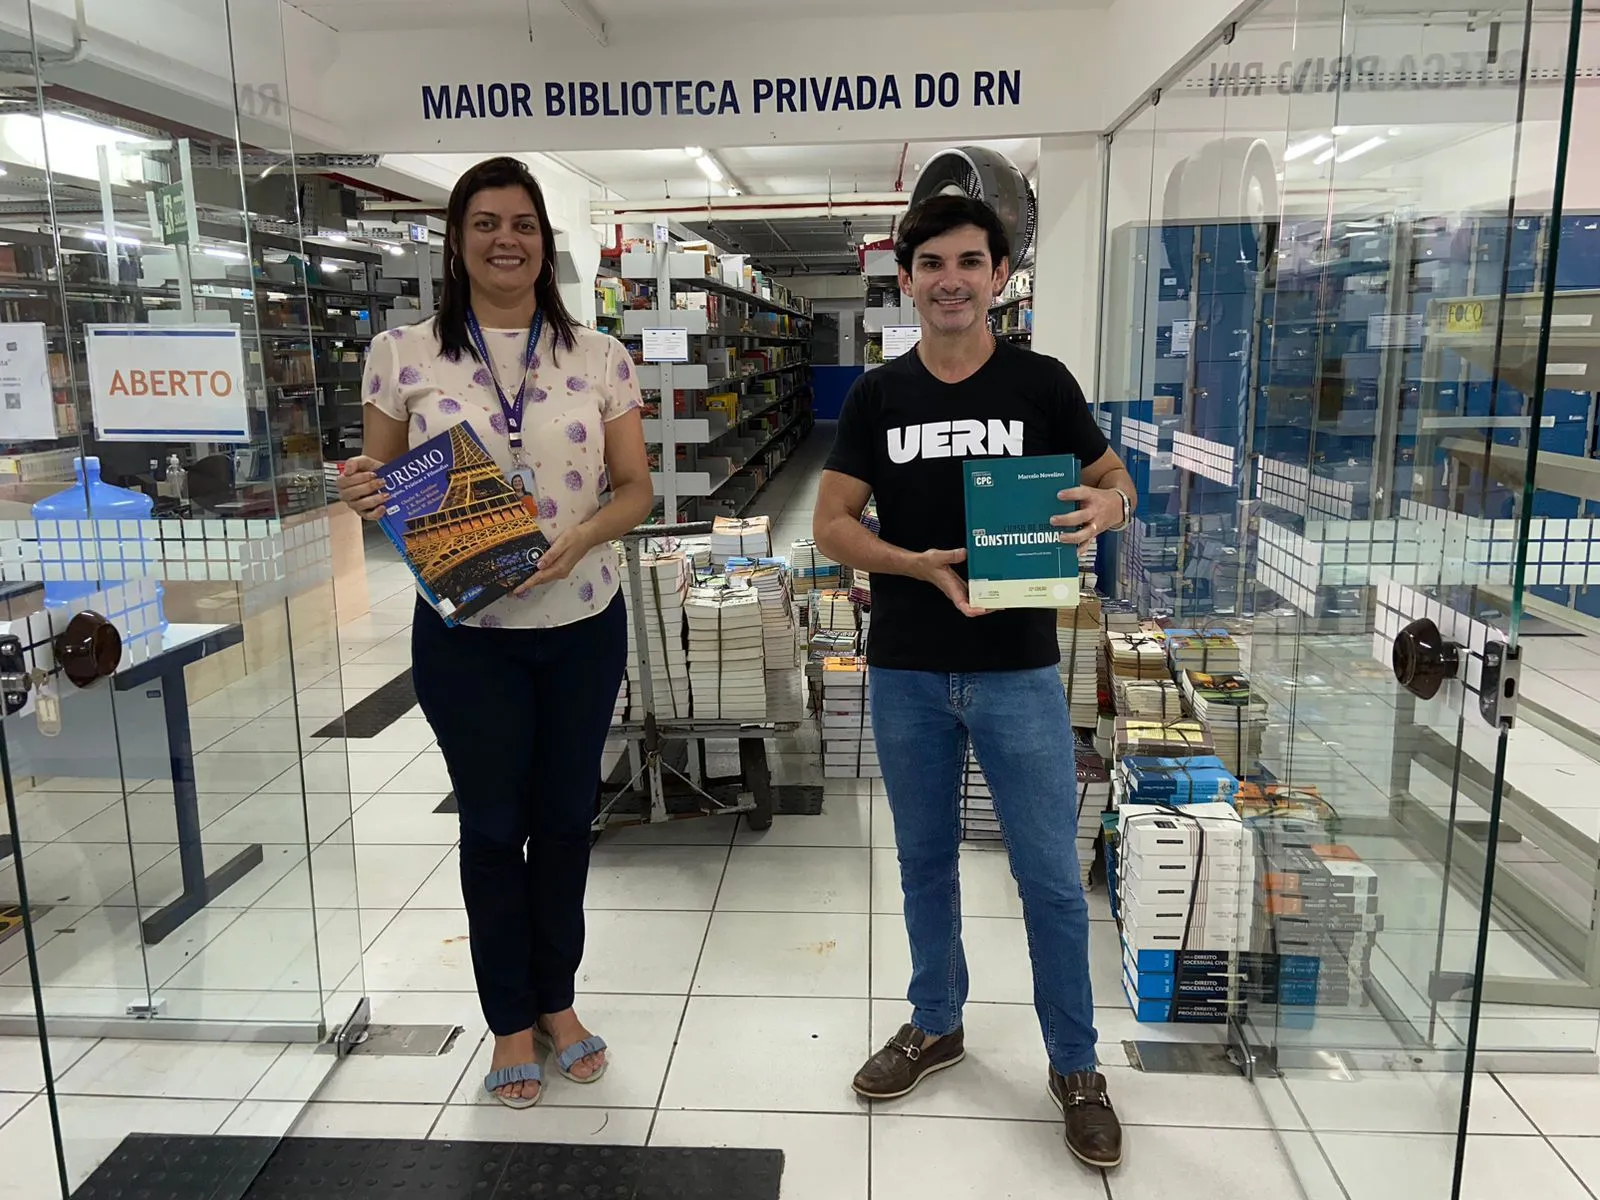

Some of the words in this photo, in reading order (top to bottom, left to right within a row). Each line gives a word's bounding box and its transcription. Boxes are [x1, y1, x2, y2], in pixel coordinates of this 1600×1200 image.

[422, 83, 533, 119] MAIOR
[544, 80, 740, 117] BIBLIOTECA
[752, 76, 901, 114] PRIVADA
[914, 72, 959, 108] DO
[973, 70, 1021, 106] RN
[109, 369, 232, 397] ABERTO
[887, 419, 1024, 464] UERN
[378, 449, 444, 494] URISMO
[976, 476, 992, 486] CPC
[1040, 471, 1065, 479] Novelino
[975, 531, 1064, 547] CONSTITUCIONA
